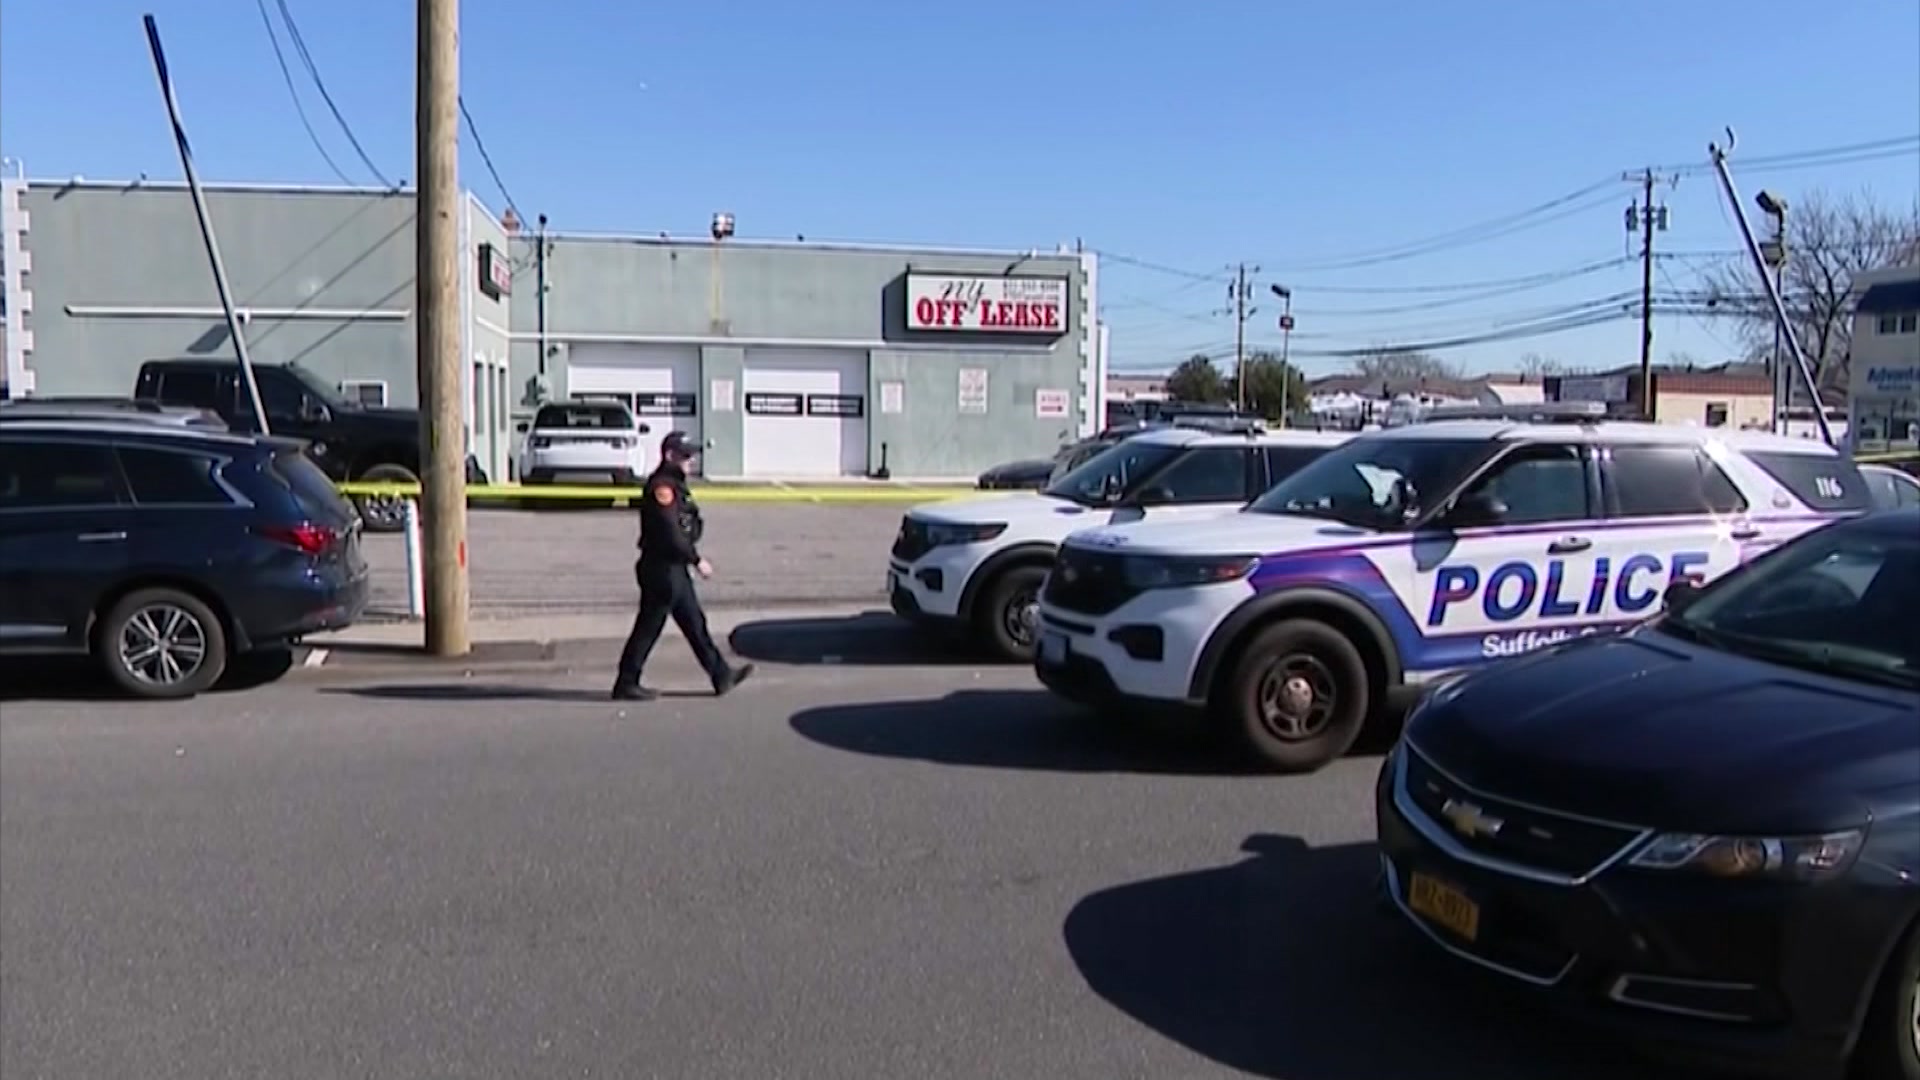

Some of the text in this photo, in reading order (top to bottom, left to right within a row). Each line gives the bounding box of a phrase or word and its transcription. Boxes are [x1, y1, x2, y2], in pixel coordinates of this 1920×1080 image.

[917, 298, 1059, 327] OFF LEASE
[1815, 477, 1843, 498] 116
